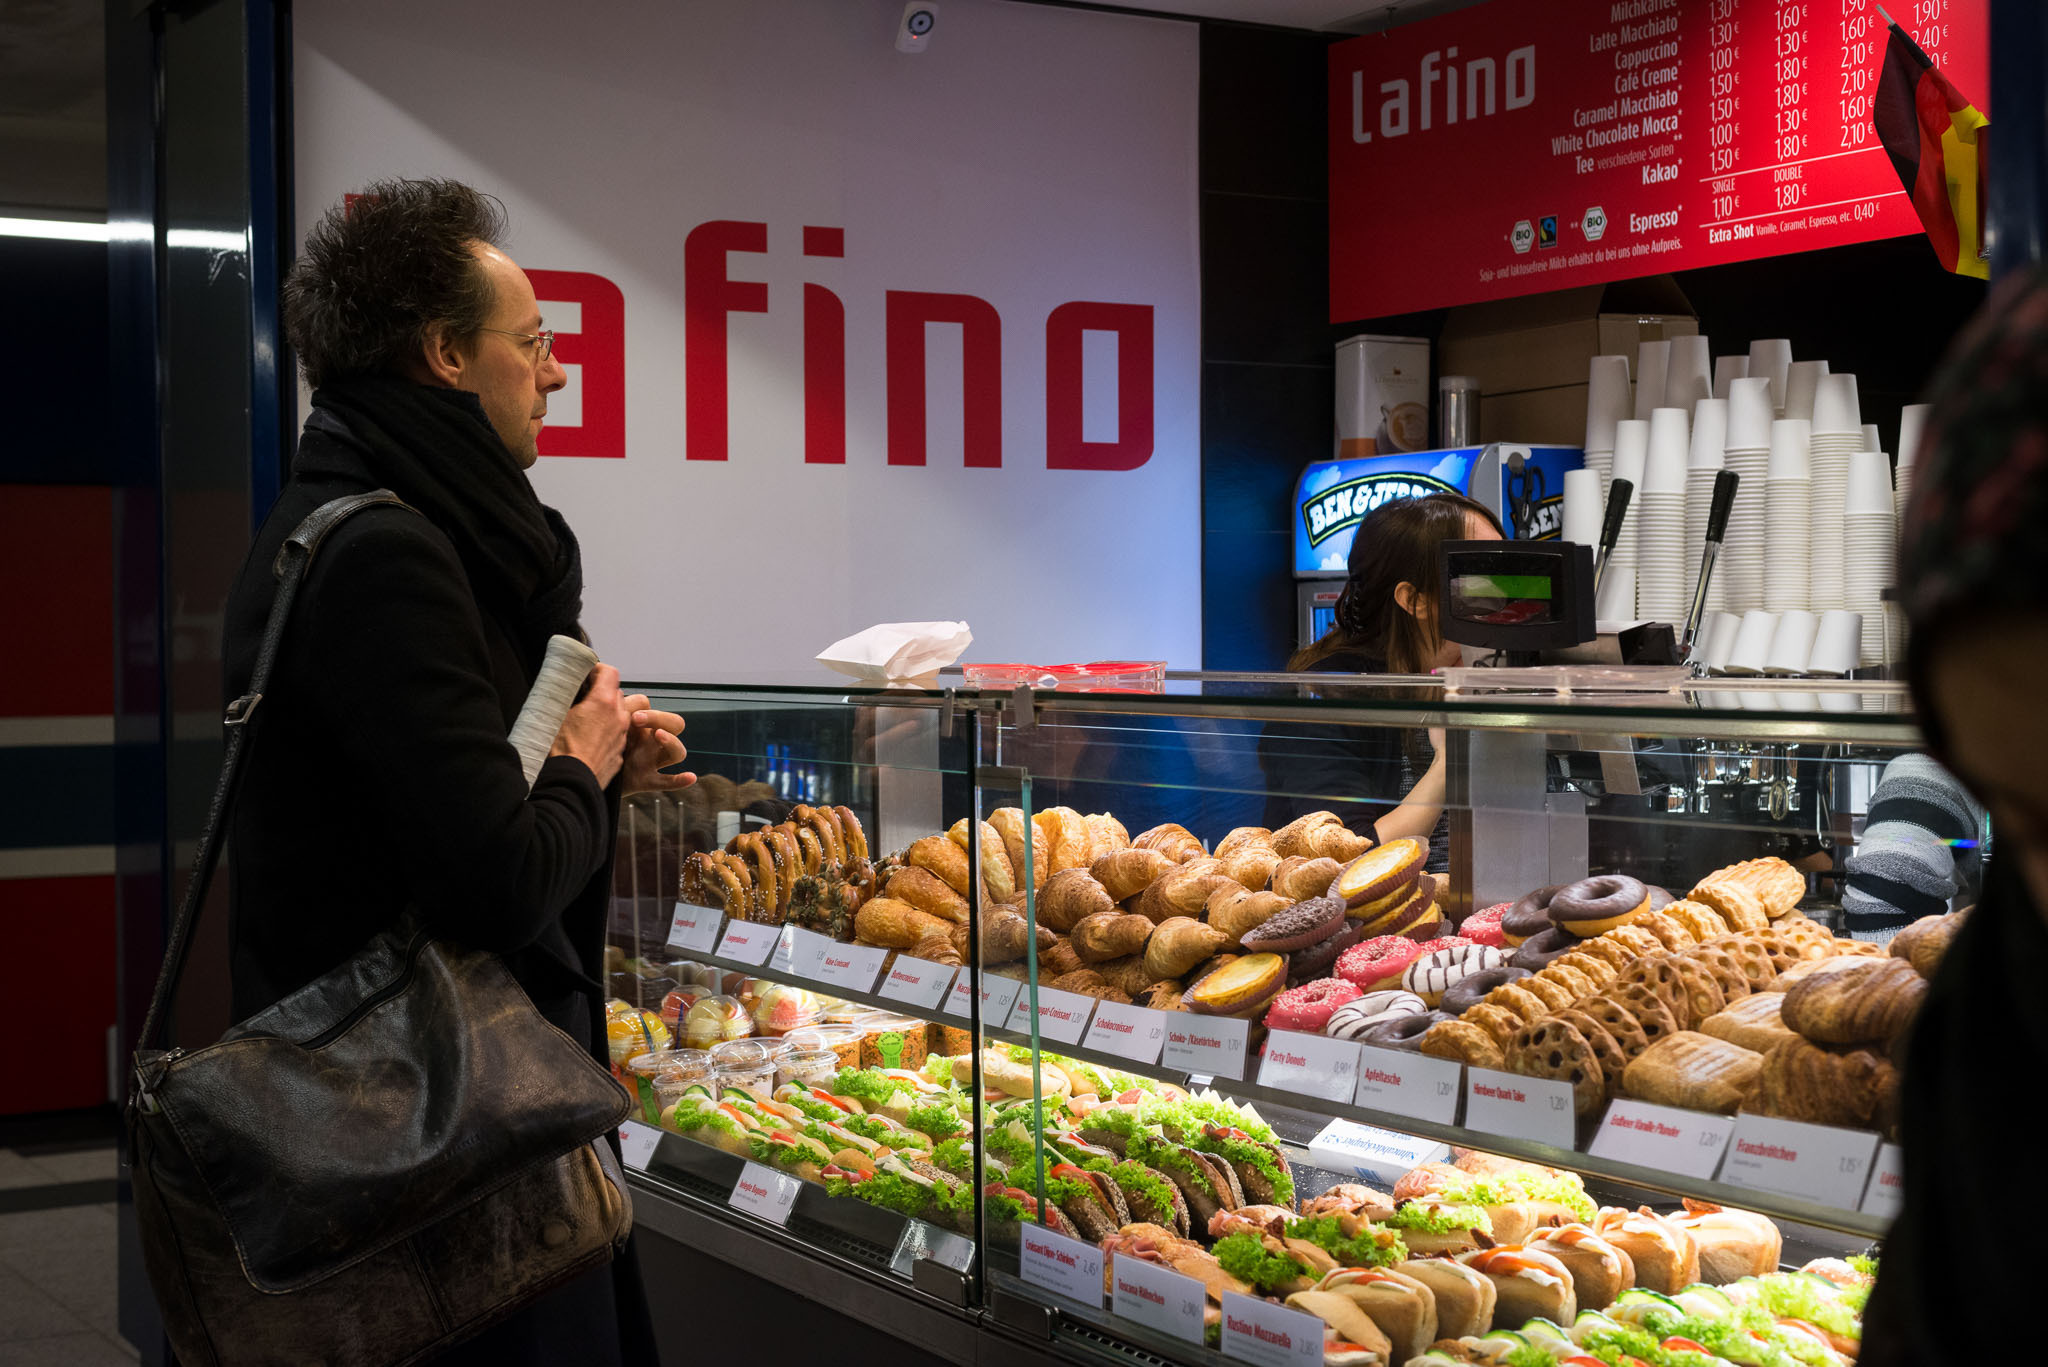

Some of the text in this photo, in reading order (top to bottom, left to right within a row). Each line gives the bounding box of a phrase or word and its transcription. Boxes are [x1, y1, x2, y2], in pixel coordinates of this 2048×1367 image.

[1590, 31, 1617, 53] Latte
[1615, 71, 1639, 95] Café
[1573, 102, 1618, 128] Caramel
[1552, 131, 1583, 156] White
[1586, 122, 1639, 150] Chocolate
[1576, 155, 1595, 175] Tee
[1597, 147, 1647, 170] verschiedene
[1712, 165, 1803, 195] SINGLE DOUBLE
[1587, 215, 1603, 228] BIO
[1709, 227, 1732, 244] Extra
[1733, 223, 1754, 240] Shot
[1840, 210, 1852, 223] etc.
[1515, 229, 1531, 241] BIO
[1497, 266, 1509, 279] und
[1510, 262, 1547, 276] laktosefreie
[1549, 257, 1567, 271] Milch
[1568, 253, 1594, 268] erhältst
[1595, 250, 1604, 262] du
[1605, 248, 1617, 260] bei
[1618, 247, 1630, 259] uns
[1632, 243, 1650, 256] ohne
[1651, 239, 1683, 257] Aufpreis.
[345, 195, 1154, 471] afino
[1095, 1017, 1134, 1035] Schokocroissant
[1269, 1050, 1285, 1065] Party
[1286, 1052, 1306, 1067] Donuts
[1364, 1067, 1401, 1086] Apfeltasche
